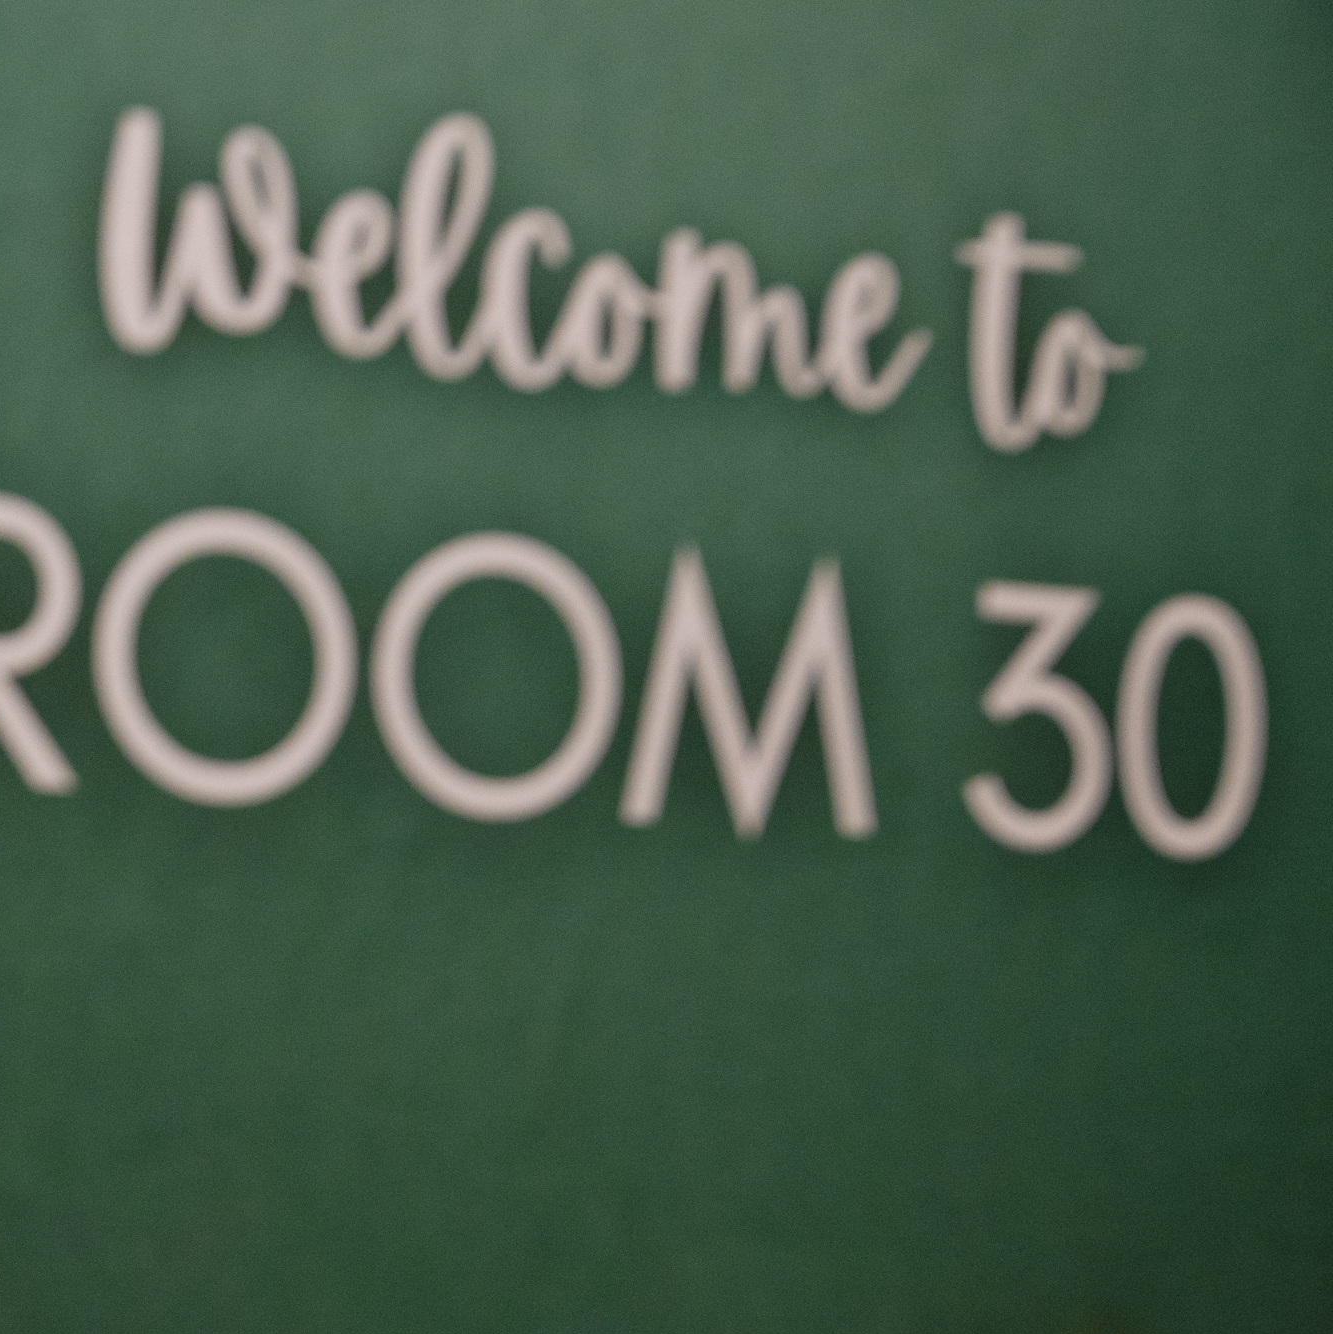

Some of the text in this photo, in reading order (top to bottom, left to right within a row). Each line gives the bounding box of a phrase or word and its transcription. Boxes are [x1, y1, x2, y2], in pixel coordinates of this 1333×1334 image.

[97, 102, 1144, 452] Welcome to
[961, 579, 1270, 861] 30
